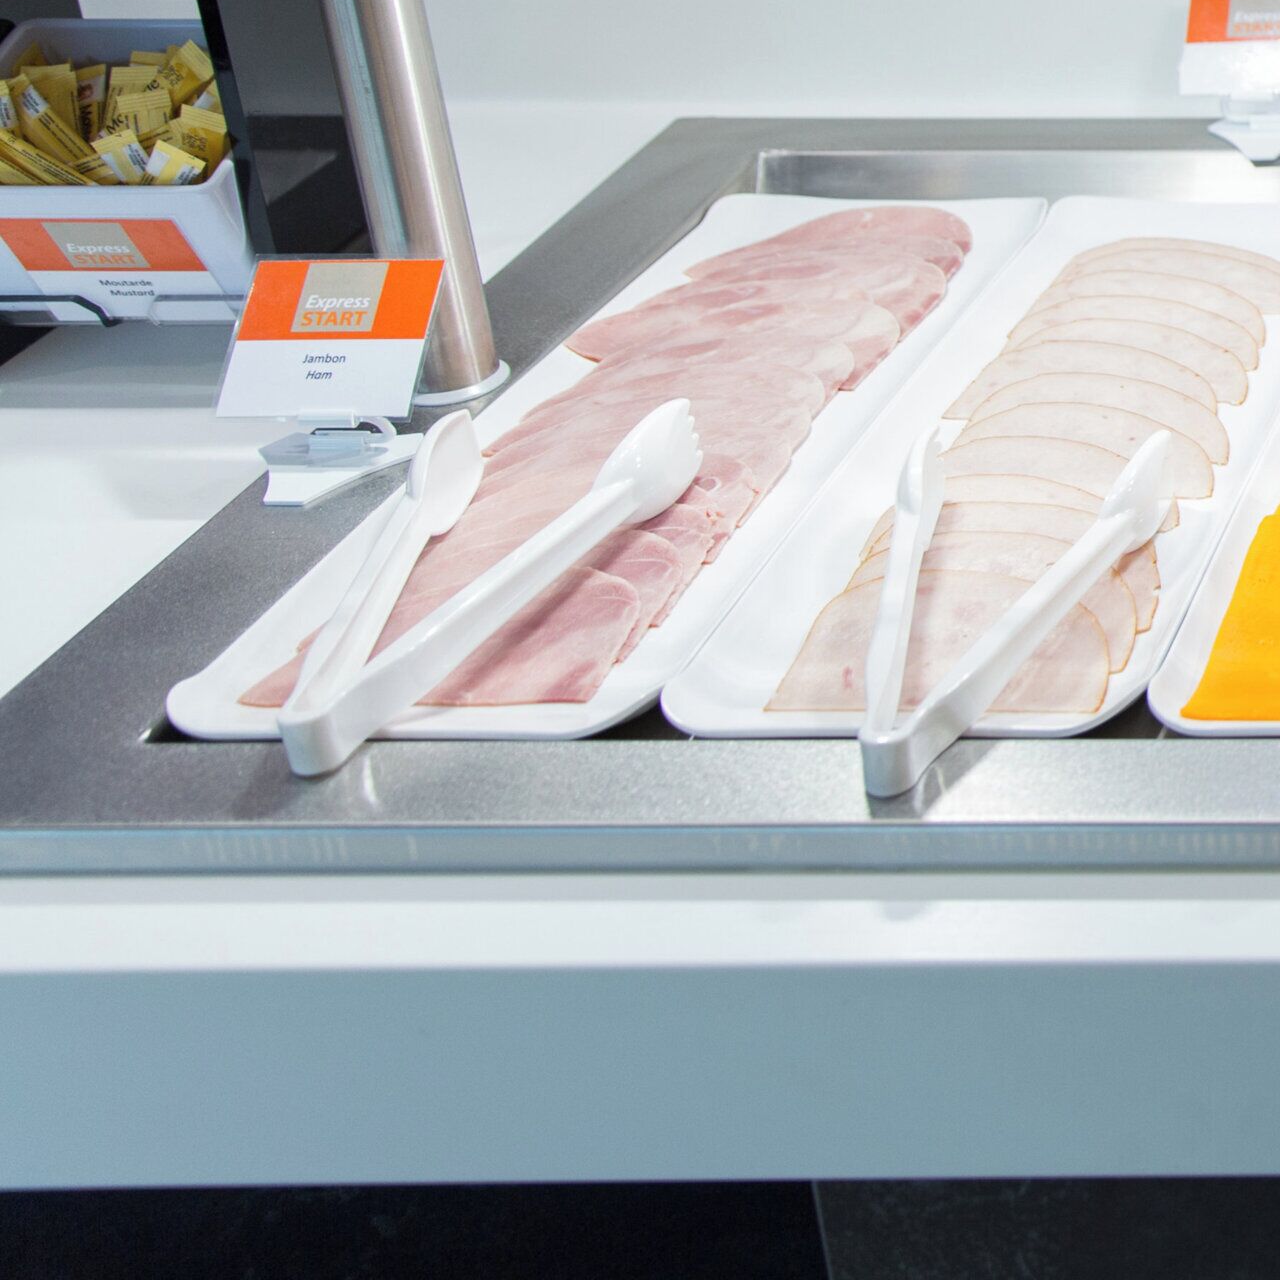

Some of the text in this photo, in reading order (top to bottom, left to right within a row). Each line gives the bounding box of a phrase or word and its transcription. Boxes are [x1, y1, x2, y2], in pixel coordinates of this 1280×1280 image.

[66, 242, 130, 254] Express
[73, 254, 137, 265] START
[98, 279, 153, 288] Moutarde
[110, 289, 155, 297] Mustard
[305, 294, 371, 312] Express
[300, 310, 369, 327] START
[302, 353, 347, 365] Jambon
[305, 370, 333, 381] Ham
